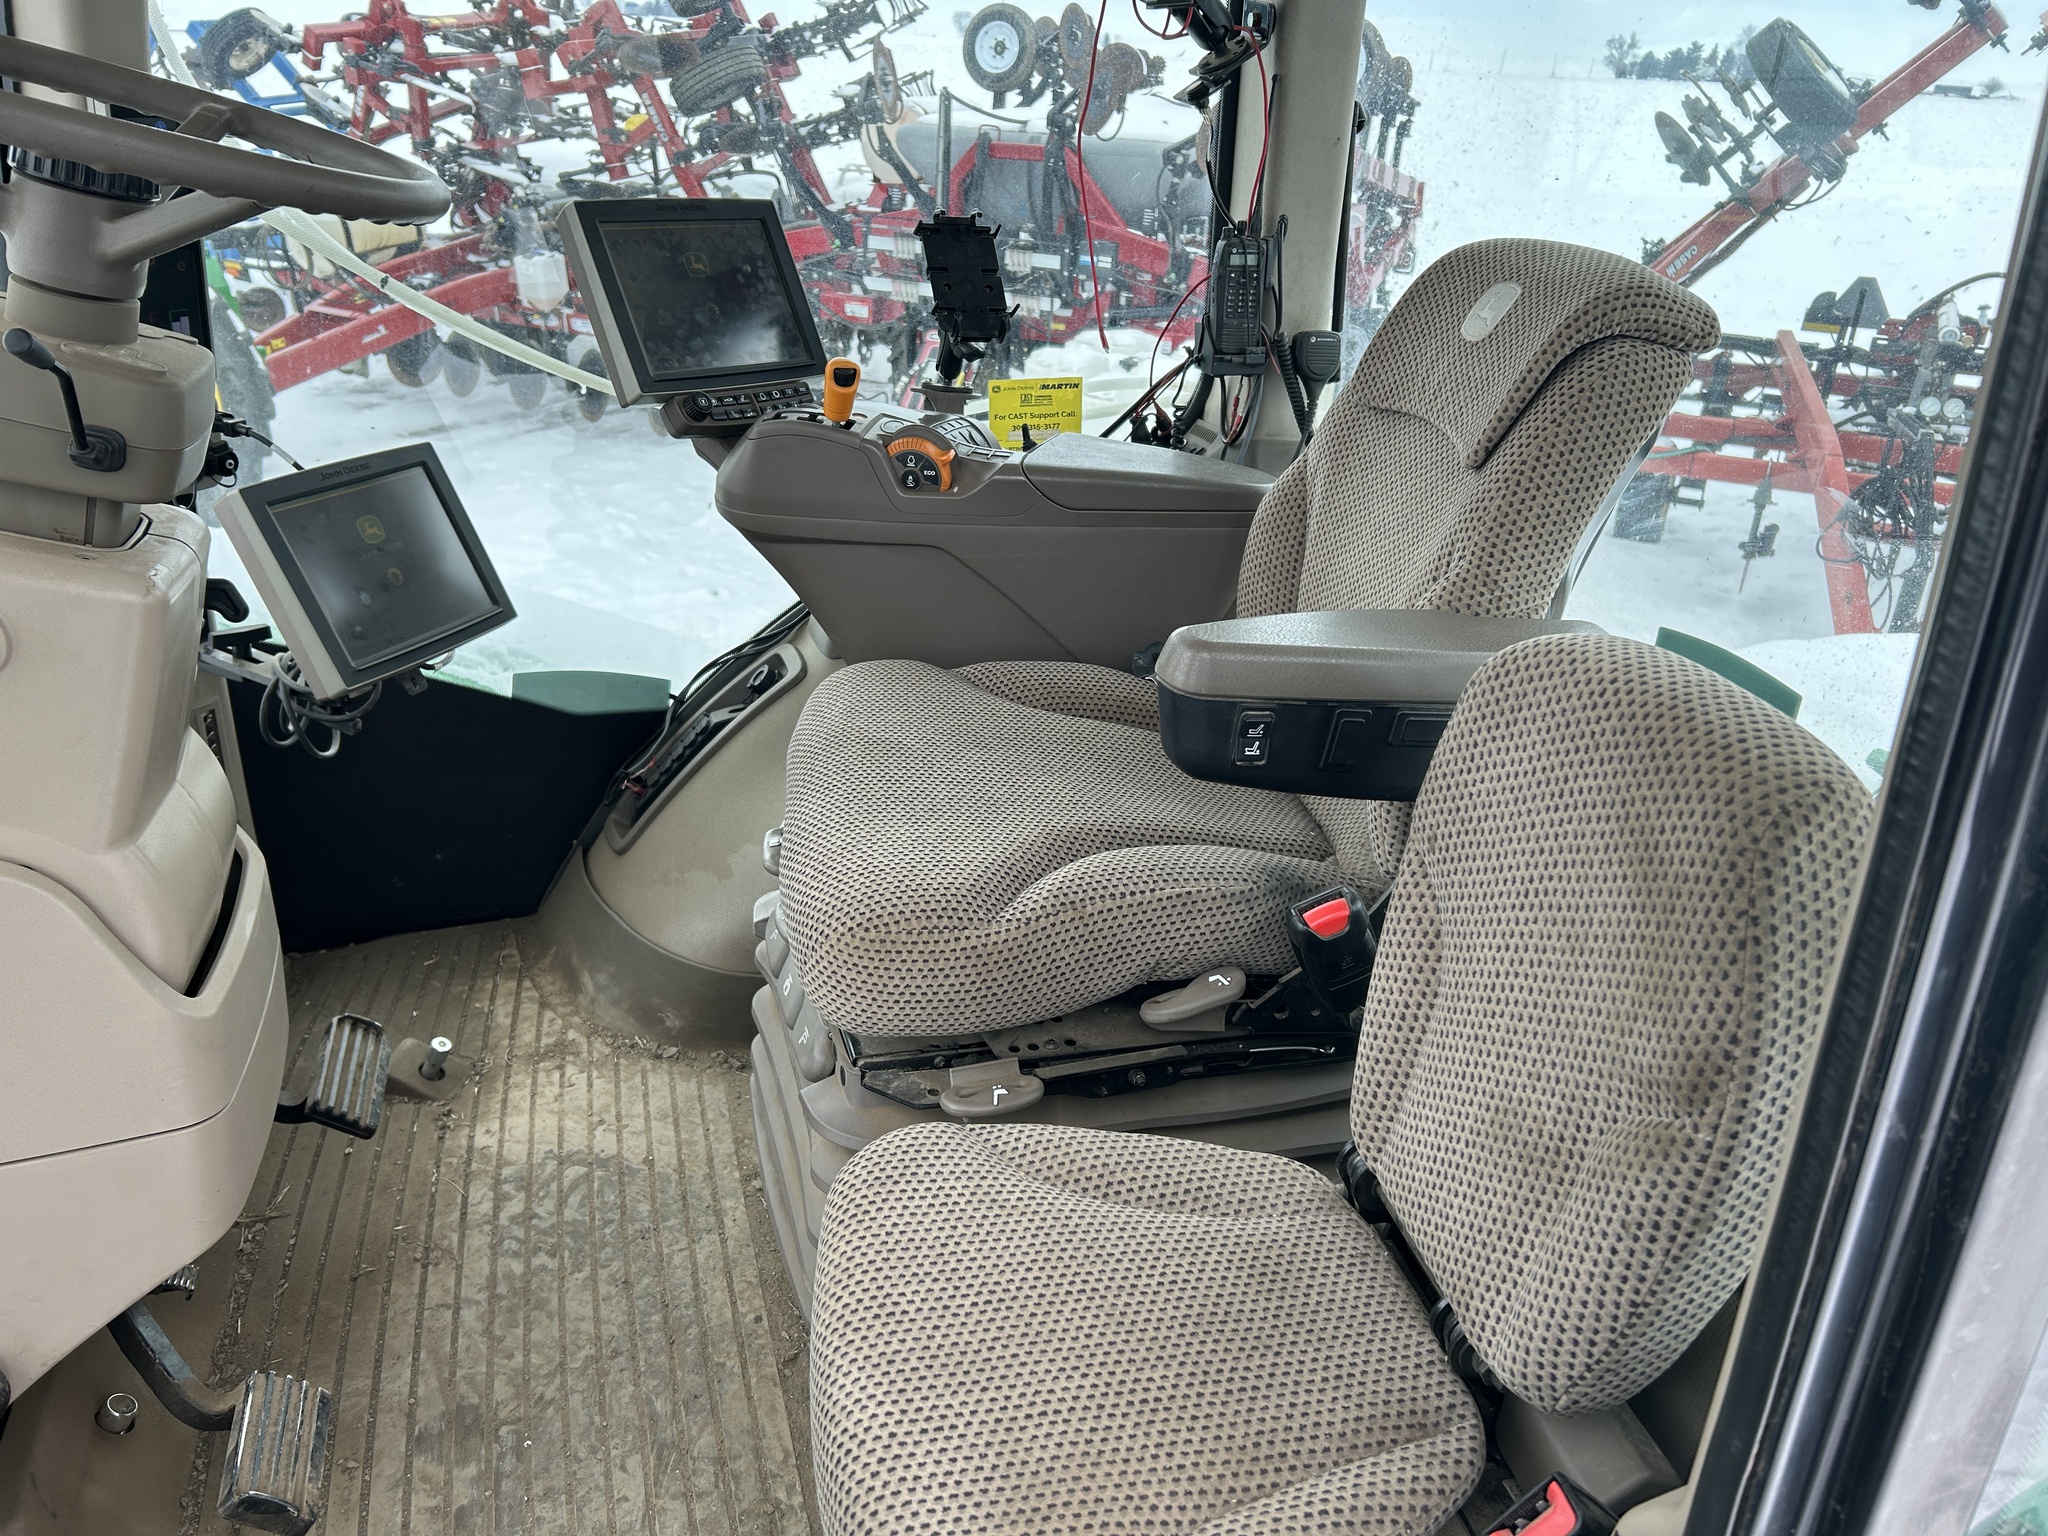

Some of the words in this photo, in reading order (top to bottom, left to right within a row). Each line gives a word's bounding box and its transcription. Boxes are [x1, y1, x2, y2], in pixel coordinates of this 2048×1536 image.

[655, 203, 678, 211] JOHN
[679, 203, 708, 211] DEERE
[994, 413, 1006, 421] For
[1008, 412, 1028, 420] CAST
[1029, 411, 1059, 420] Support
[1061, 410, 1078, 418] Call:
[320, 469, 344, 481] JOHN
[344, 462, 372, 475] DEERE
